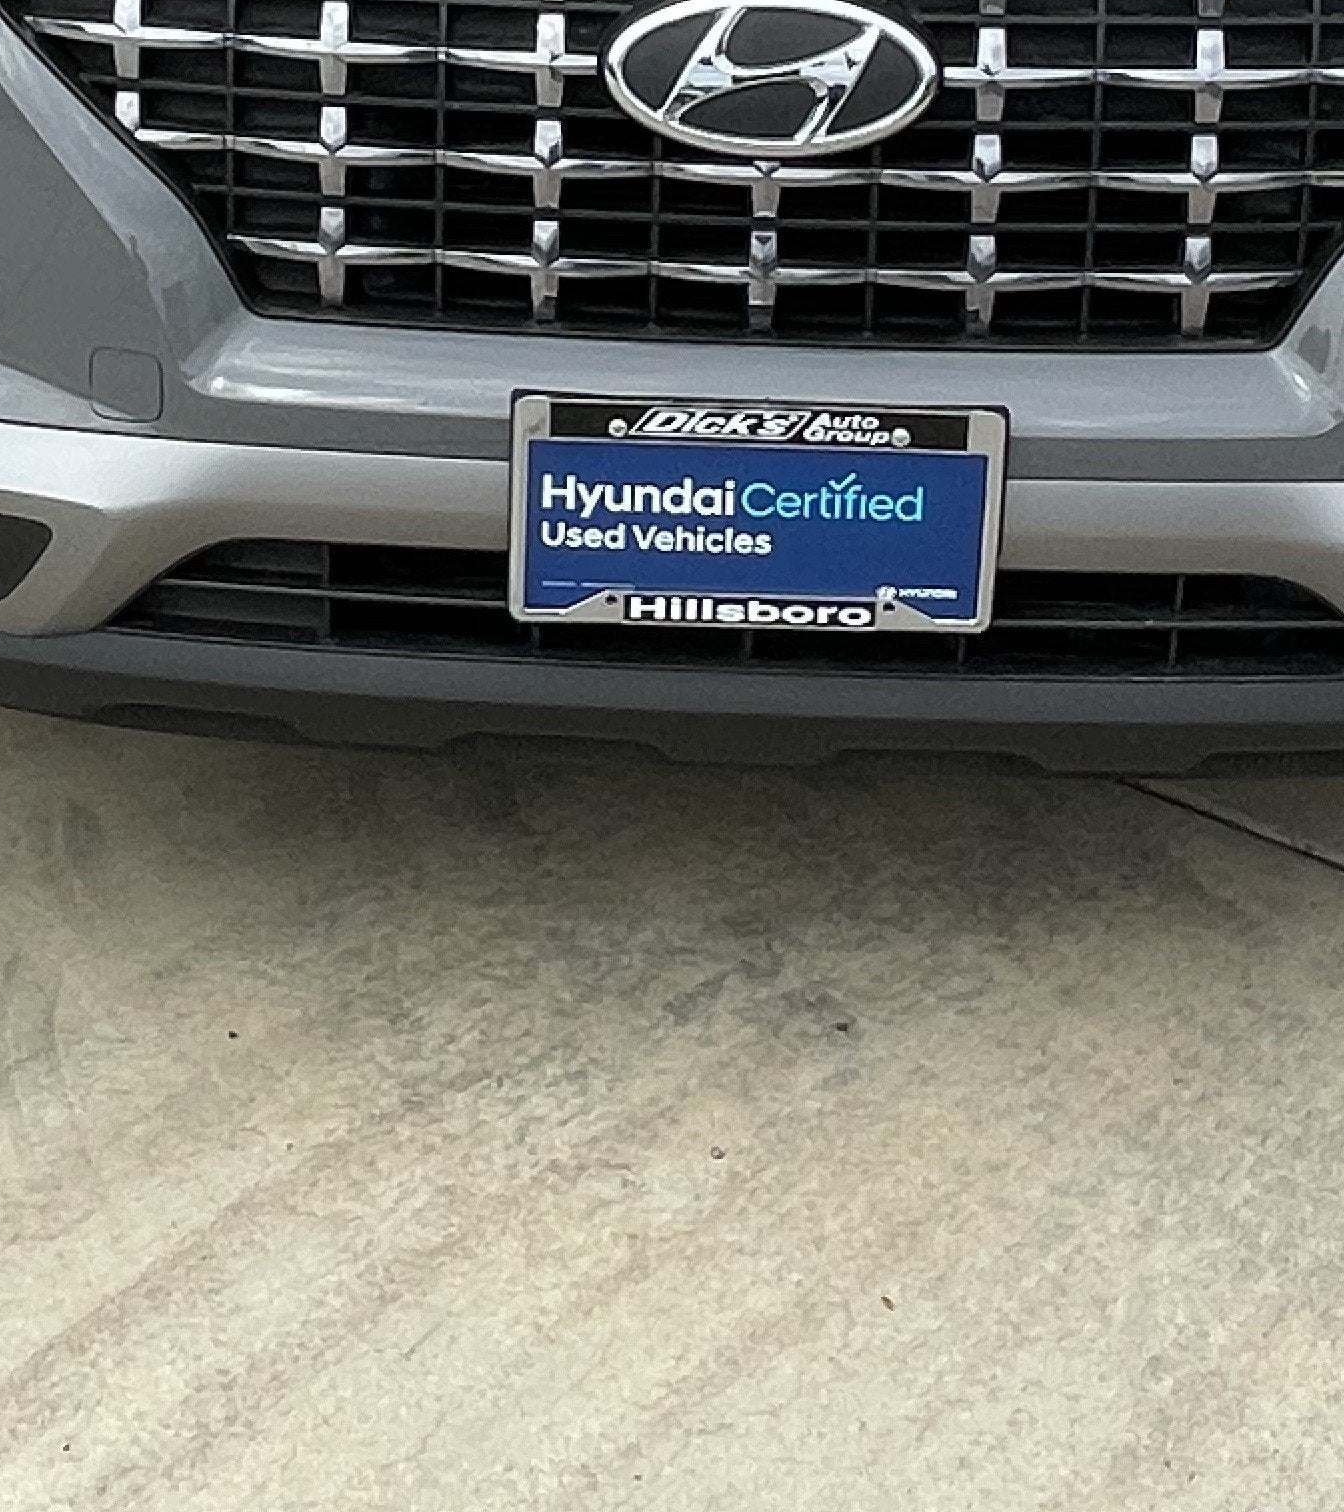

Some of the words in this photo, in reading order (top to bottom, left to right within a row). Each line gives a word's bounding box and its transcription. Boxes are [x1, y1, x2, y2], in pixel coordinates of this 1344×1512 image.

[803, 427, 891, 446] Group
[808, 412, 880, 431] Auto
[541, 473, 736, 519] Hyundai
[741, 471, 924, 522] Certified
[541, 519, 626, 550] Used
[632, 523, 773, 555] Vehicles
[629, 595, 872, 626] Hillsboro
